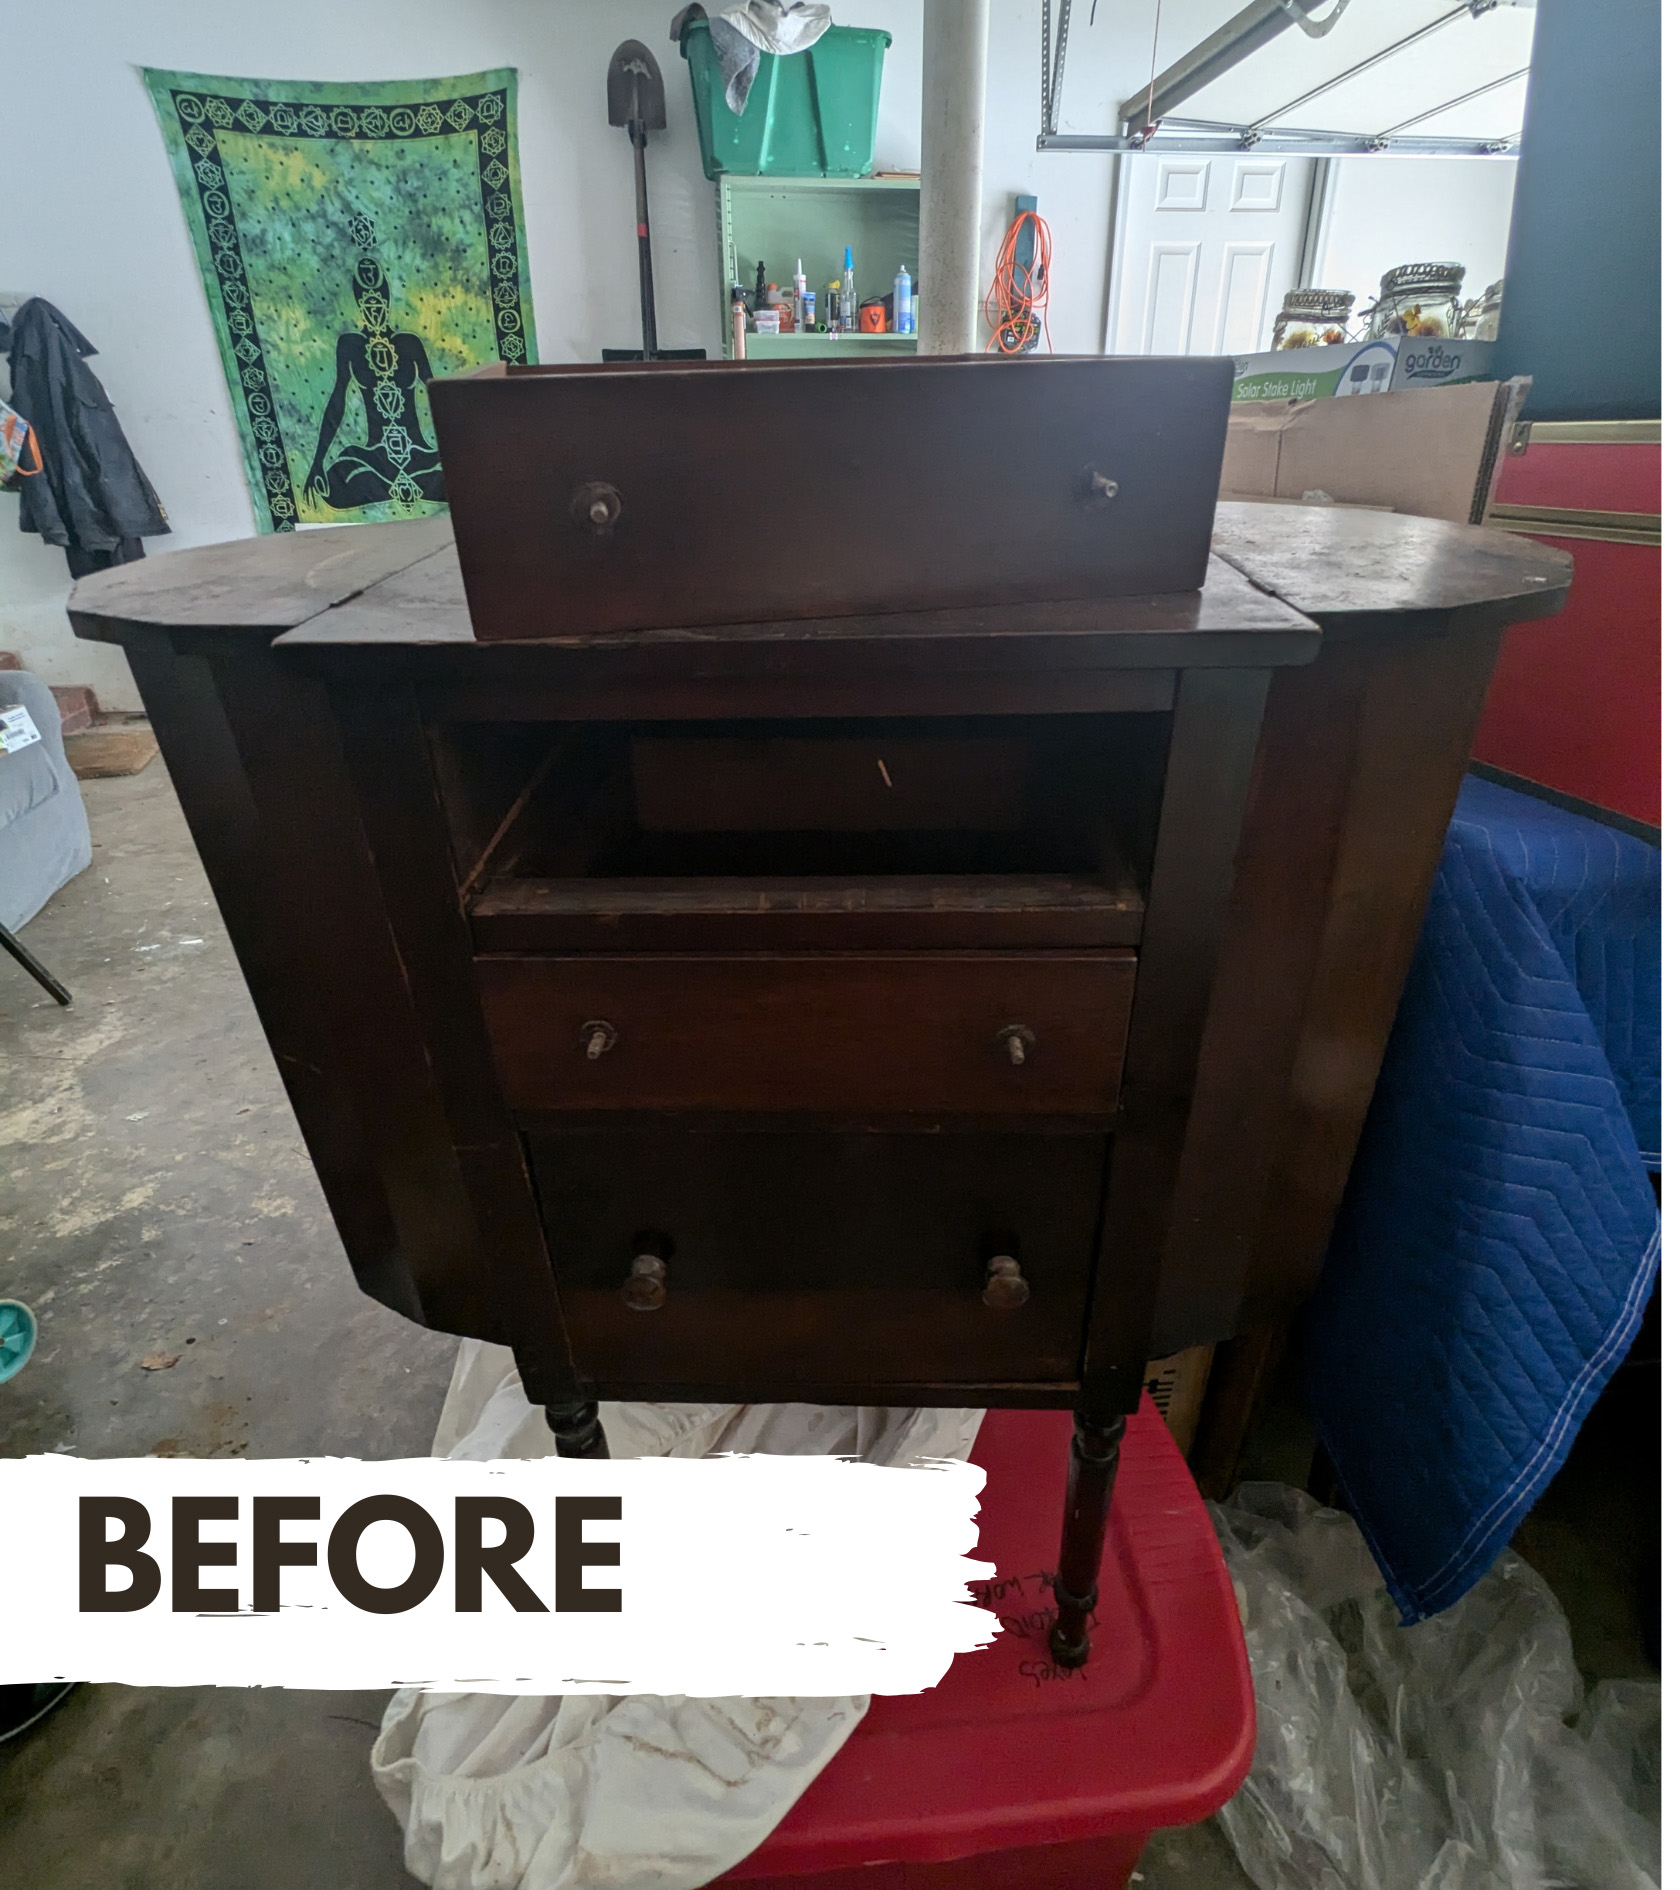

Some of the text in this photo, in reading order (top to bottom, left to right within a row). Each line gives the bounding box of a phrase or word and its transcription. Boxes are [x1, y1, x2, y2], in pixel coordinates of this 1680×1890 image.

[1405, 347, 1462, 373] garden
[1237, 378, 1317, 399] Solar Stake Light
